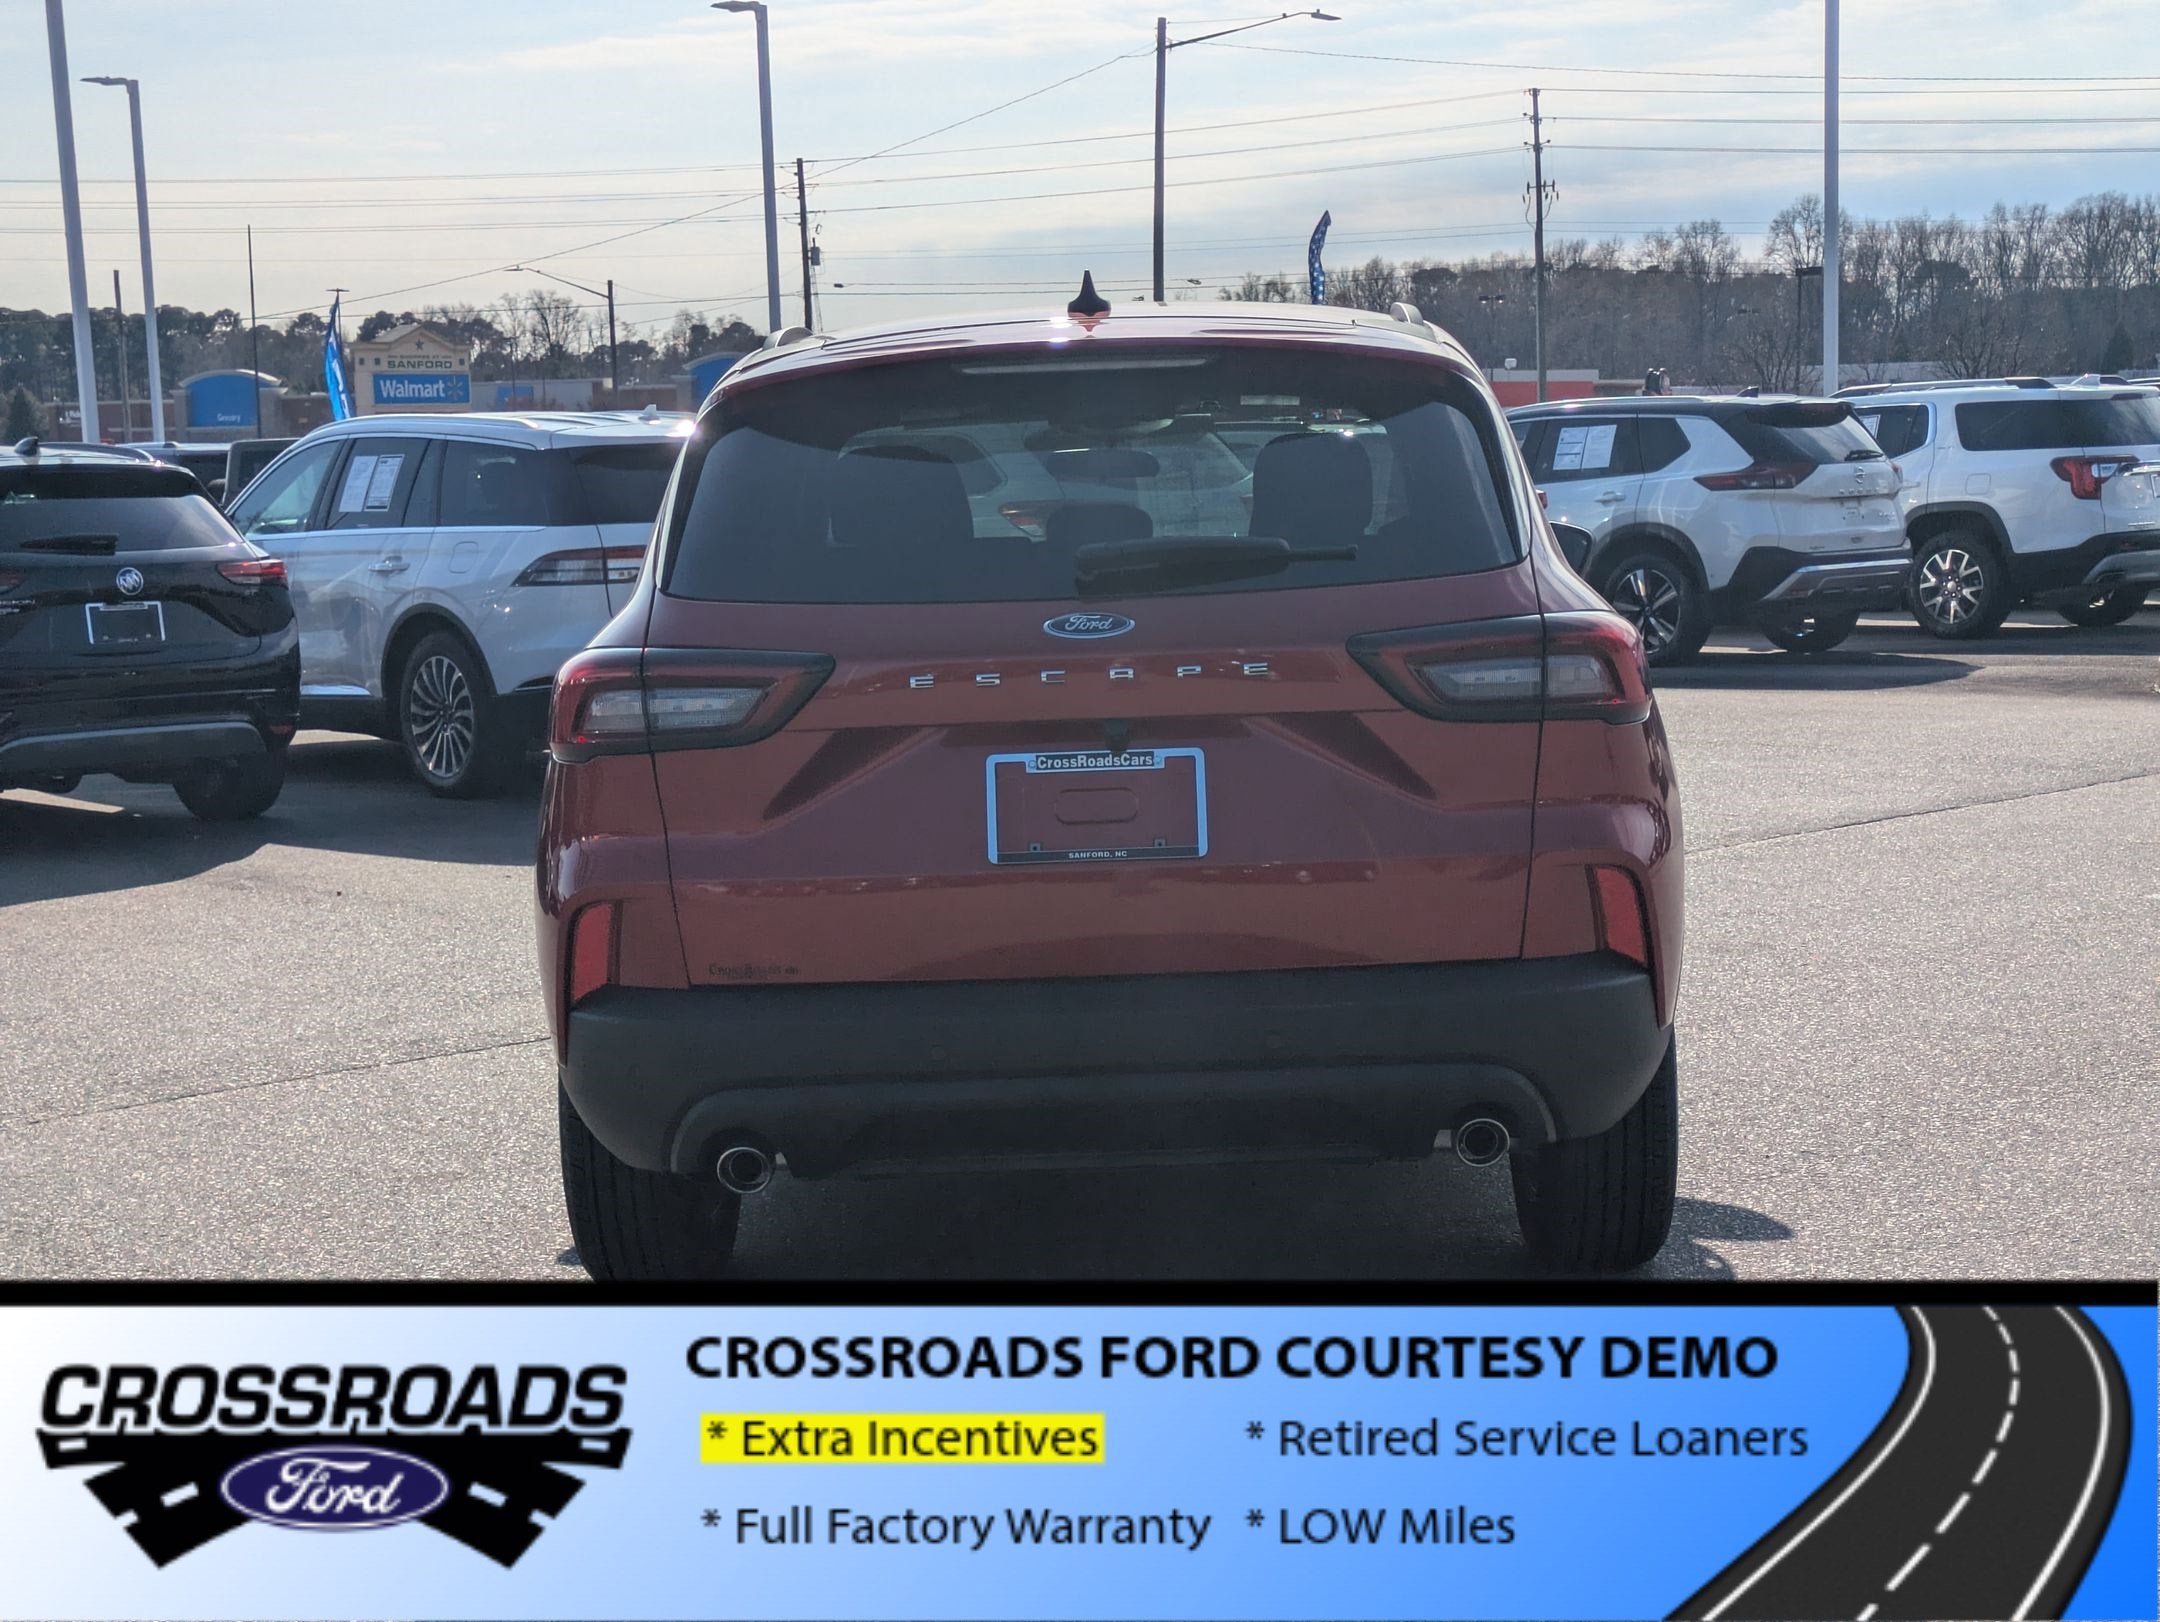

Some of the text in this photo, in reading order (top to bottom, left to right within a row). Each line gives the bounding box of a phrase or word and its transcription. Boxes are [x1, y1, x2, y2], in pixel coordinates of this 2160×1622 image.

[387, 360, 453, 369] SANFORD
[379, 379, 446, 398] Walmart
[1064, 614, 1113, 632] Ford
[909, 662, 1269, 689] ESCAPE
[1037, 753, 1153, 769] CrossRoadsCars
[1115, 850, 1128, 858] NC
